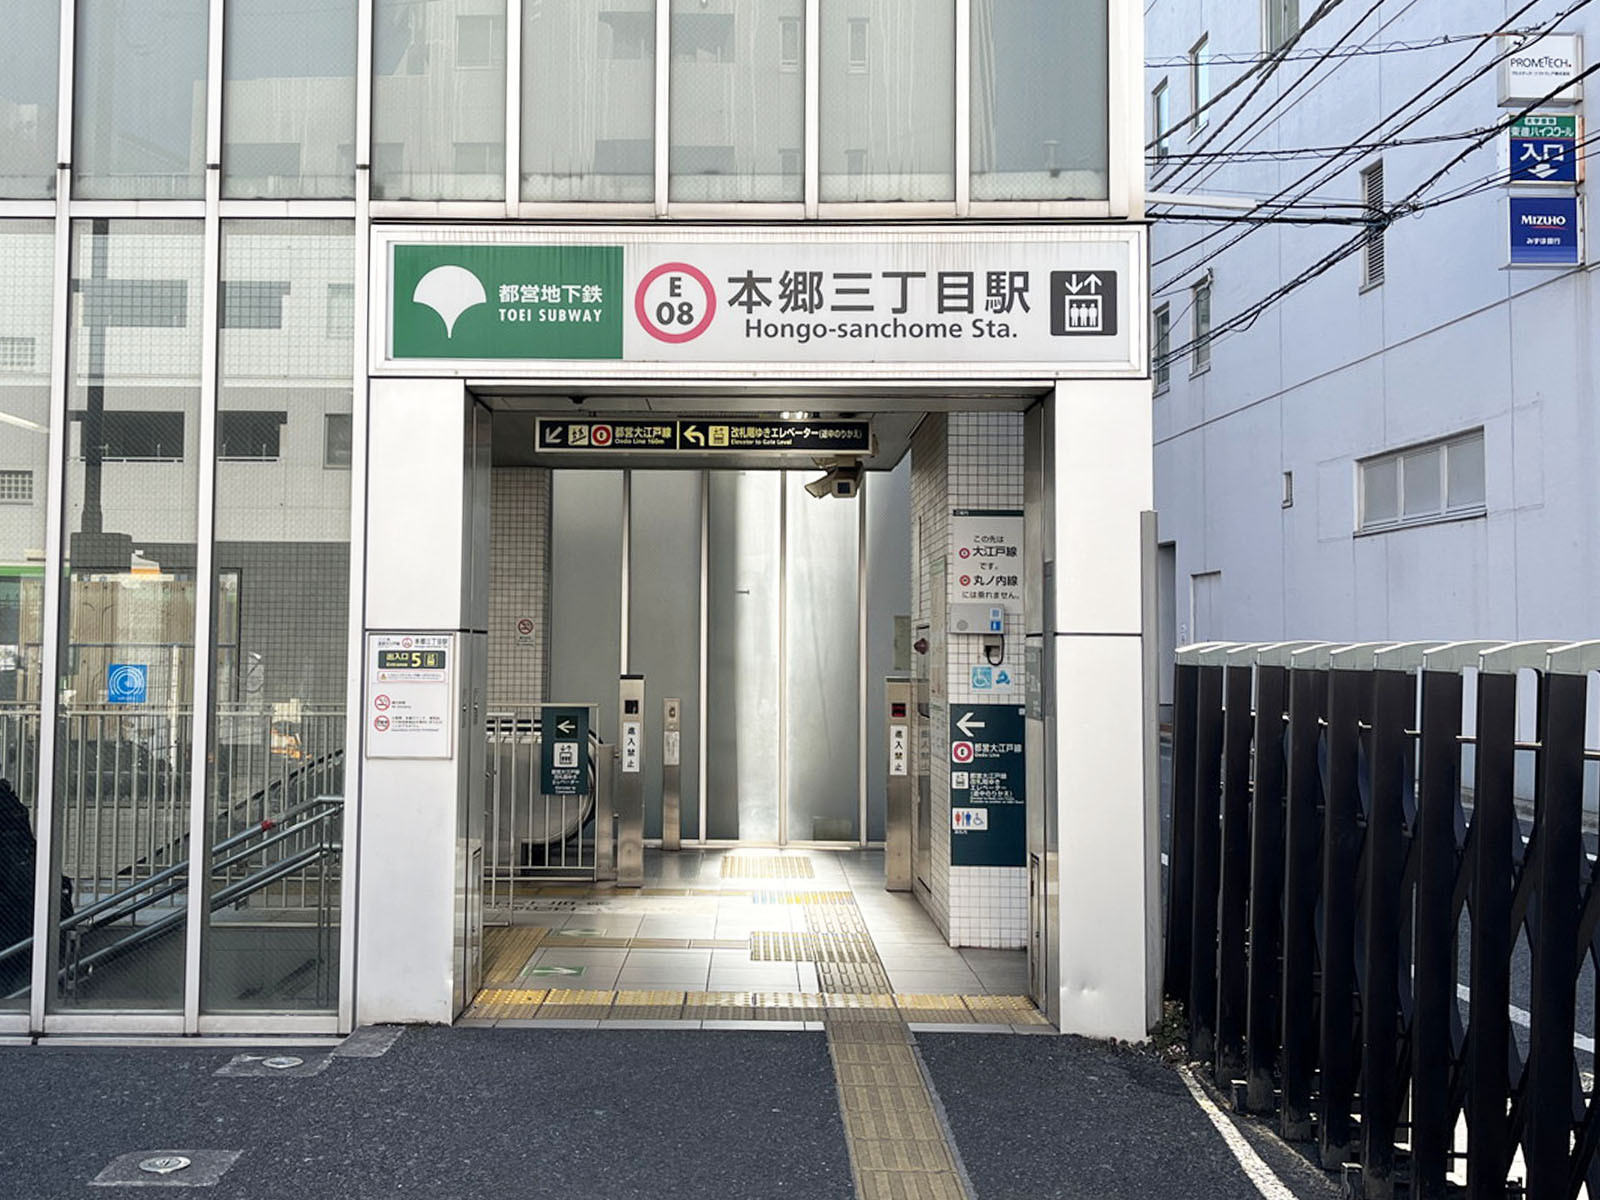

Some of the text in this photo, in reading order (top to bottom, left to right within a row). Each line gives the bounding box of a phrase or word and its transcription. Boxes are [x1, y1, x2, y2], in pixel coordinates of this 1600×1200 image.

[1520, 143, 1564, 162] 入口
[1521, 215, 1567, 225] MIZUHO
[1526, 237, 1561, 245] みずほ銀行
[669, 276, 682, 298] E
[728, 270, 1031, 314] 本郷三丁目駅
[498, 284, 603, 304] 都営地下鉄
[498, 308, 603, 322] TOEI SUBWAY
[656, 301, 694, 326] 08
[745, 318, 1018, 343] Hongo-sanchome Sta.
[614, 426, 672, 438] 都営大江戸線
[973, 535, 1004, 544] この先は
[972, 546, 1018, 558] 大江戸線
[973, 575, 1018, 587] 丸ノ内線
[962, 591, 1020, 600] には乗れません。
[411, 652, 421, 667] 5
[974, 743, 1023, 753] 都営大江戸線
